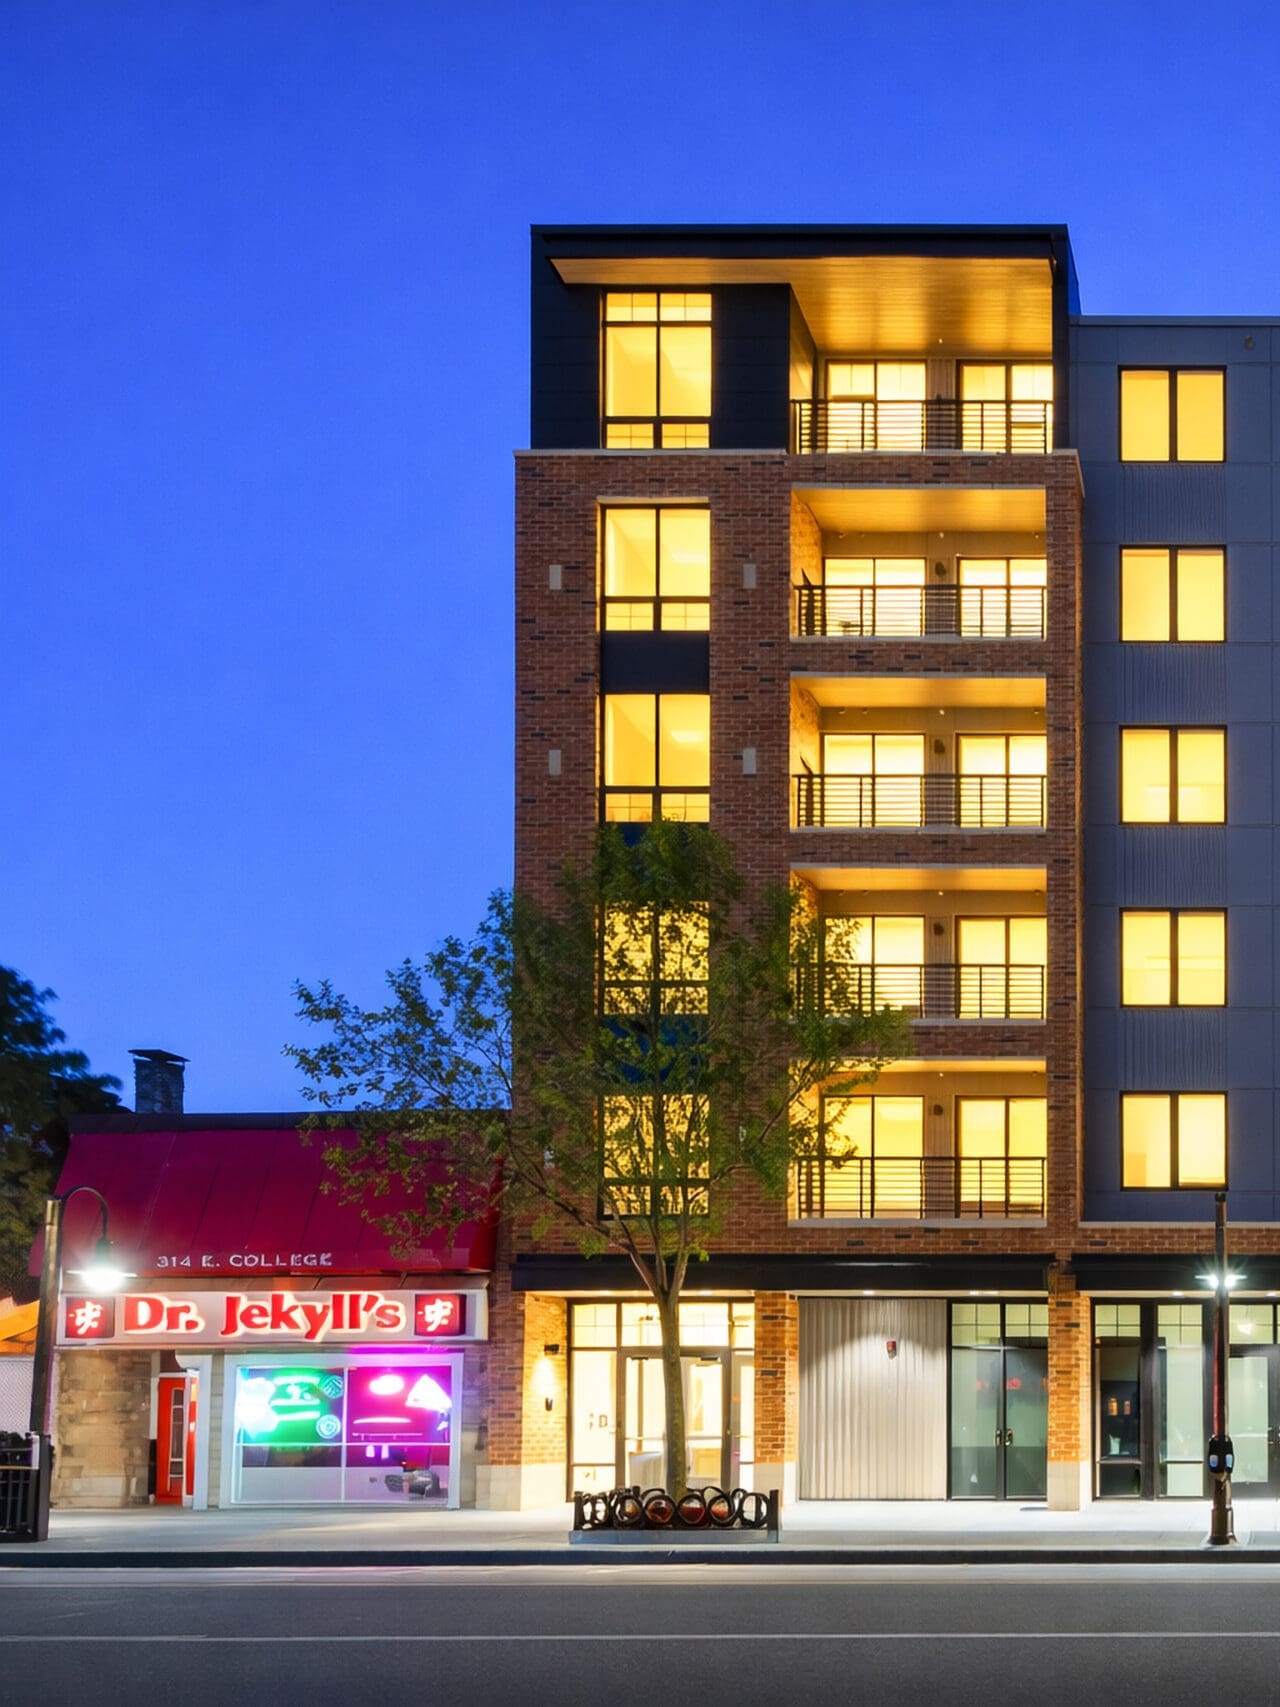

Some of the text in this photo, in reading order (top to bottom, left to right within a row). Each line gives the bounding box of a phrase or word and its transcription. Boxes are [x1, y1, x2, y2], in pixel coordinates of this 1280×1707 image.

[157, 1255, 191, 1268] 314
[229, 1253, 332, 1267] COLLEGE
[123, 1292, 403, 1341] Dr. Jekyll's
